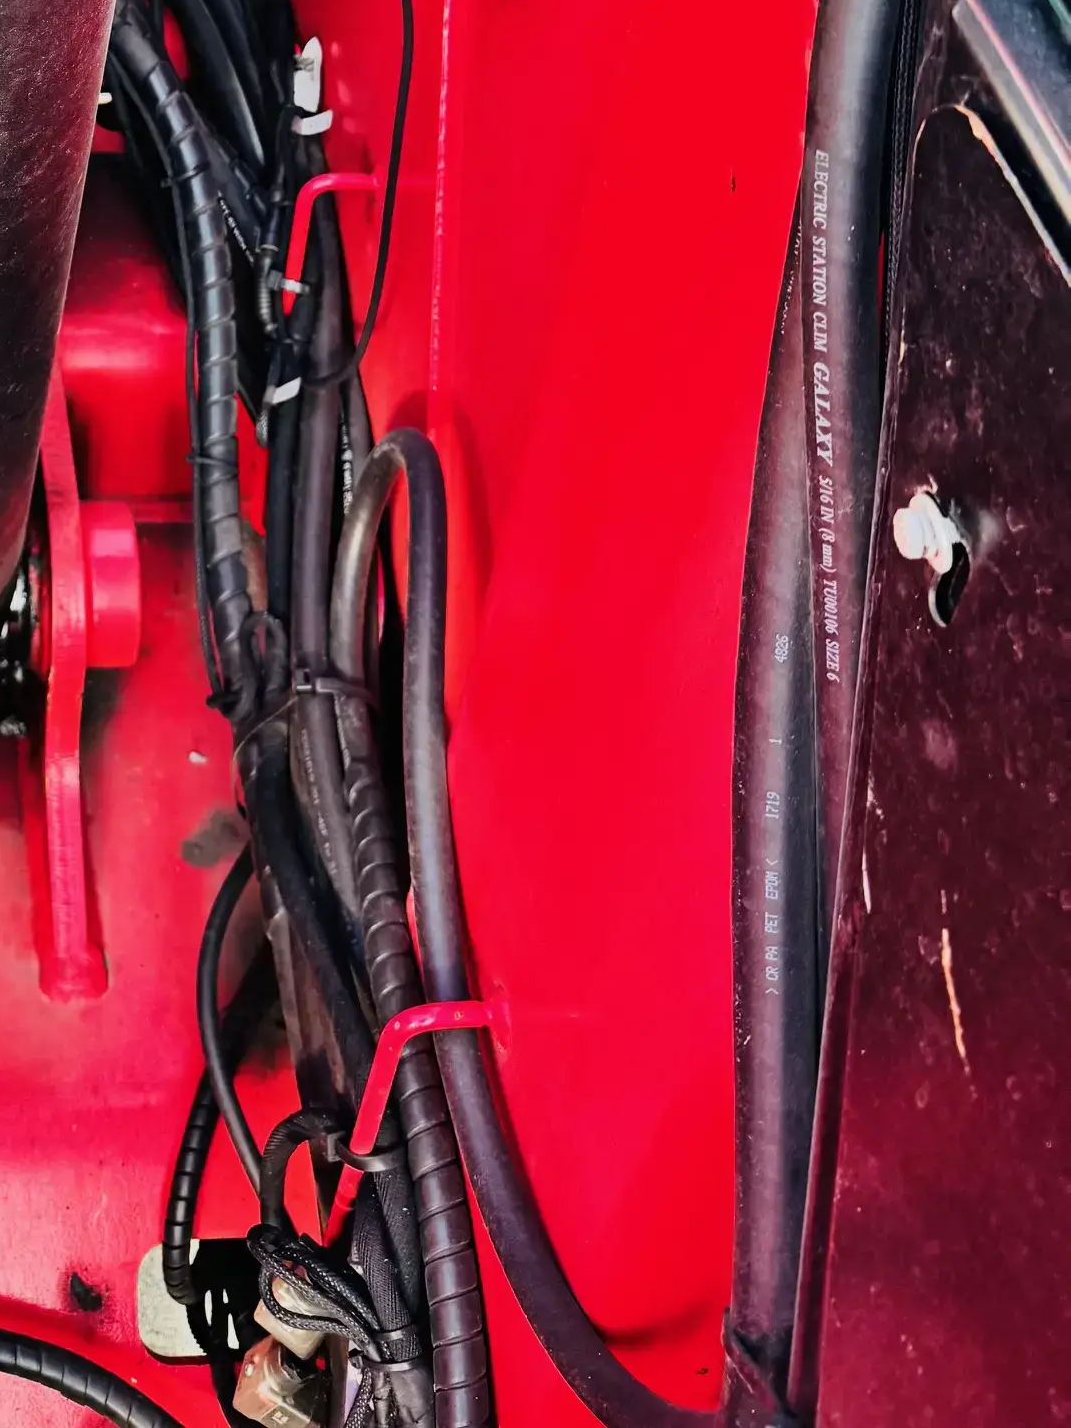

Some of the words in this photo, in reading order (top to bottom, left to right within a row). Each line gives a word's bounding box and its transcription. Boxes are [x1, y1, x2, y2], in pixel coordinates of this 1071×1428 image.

[813, 149, 829, 230] ELECTRIC
[812, 235, 827, 306] STATION
[813, 311, 828, 353] CLIM
[813, 361, 833, 467] GALAXY
[818, 474, 834, 505] 5/16
[820, 504, 835, 525] IN
[823, 579, 839, 635] TU00106
[825, 638, 840, 672] SIZE
[826, 672, 840, 683] 6
[766, 791, 780, 819] 1719
[765, 911, 779, 934] PET
[765, 946, 779, 961] PA
